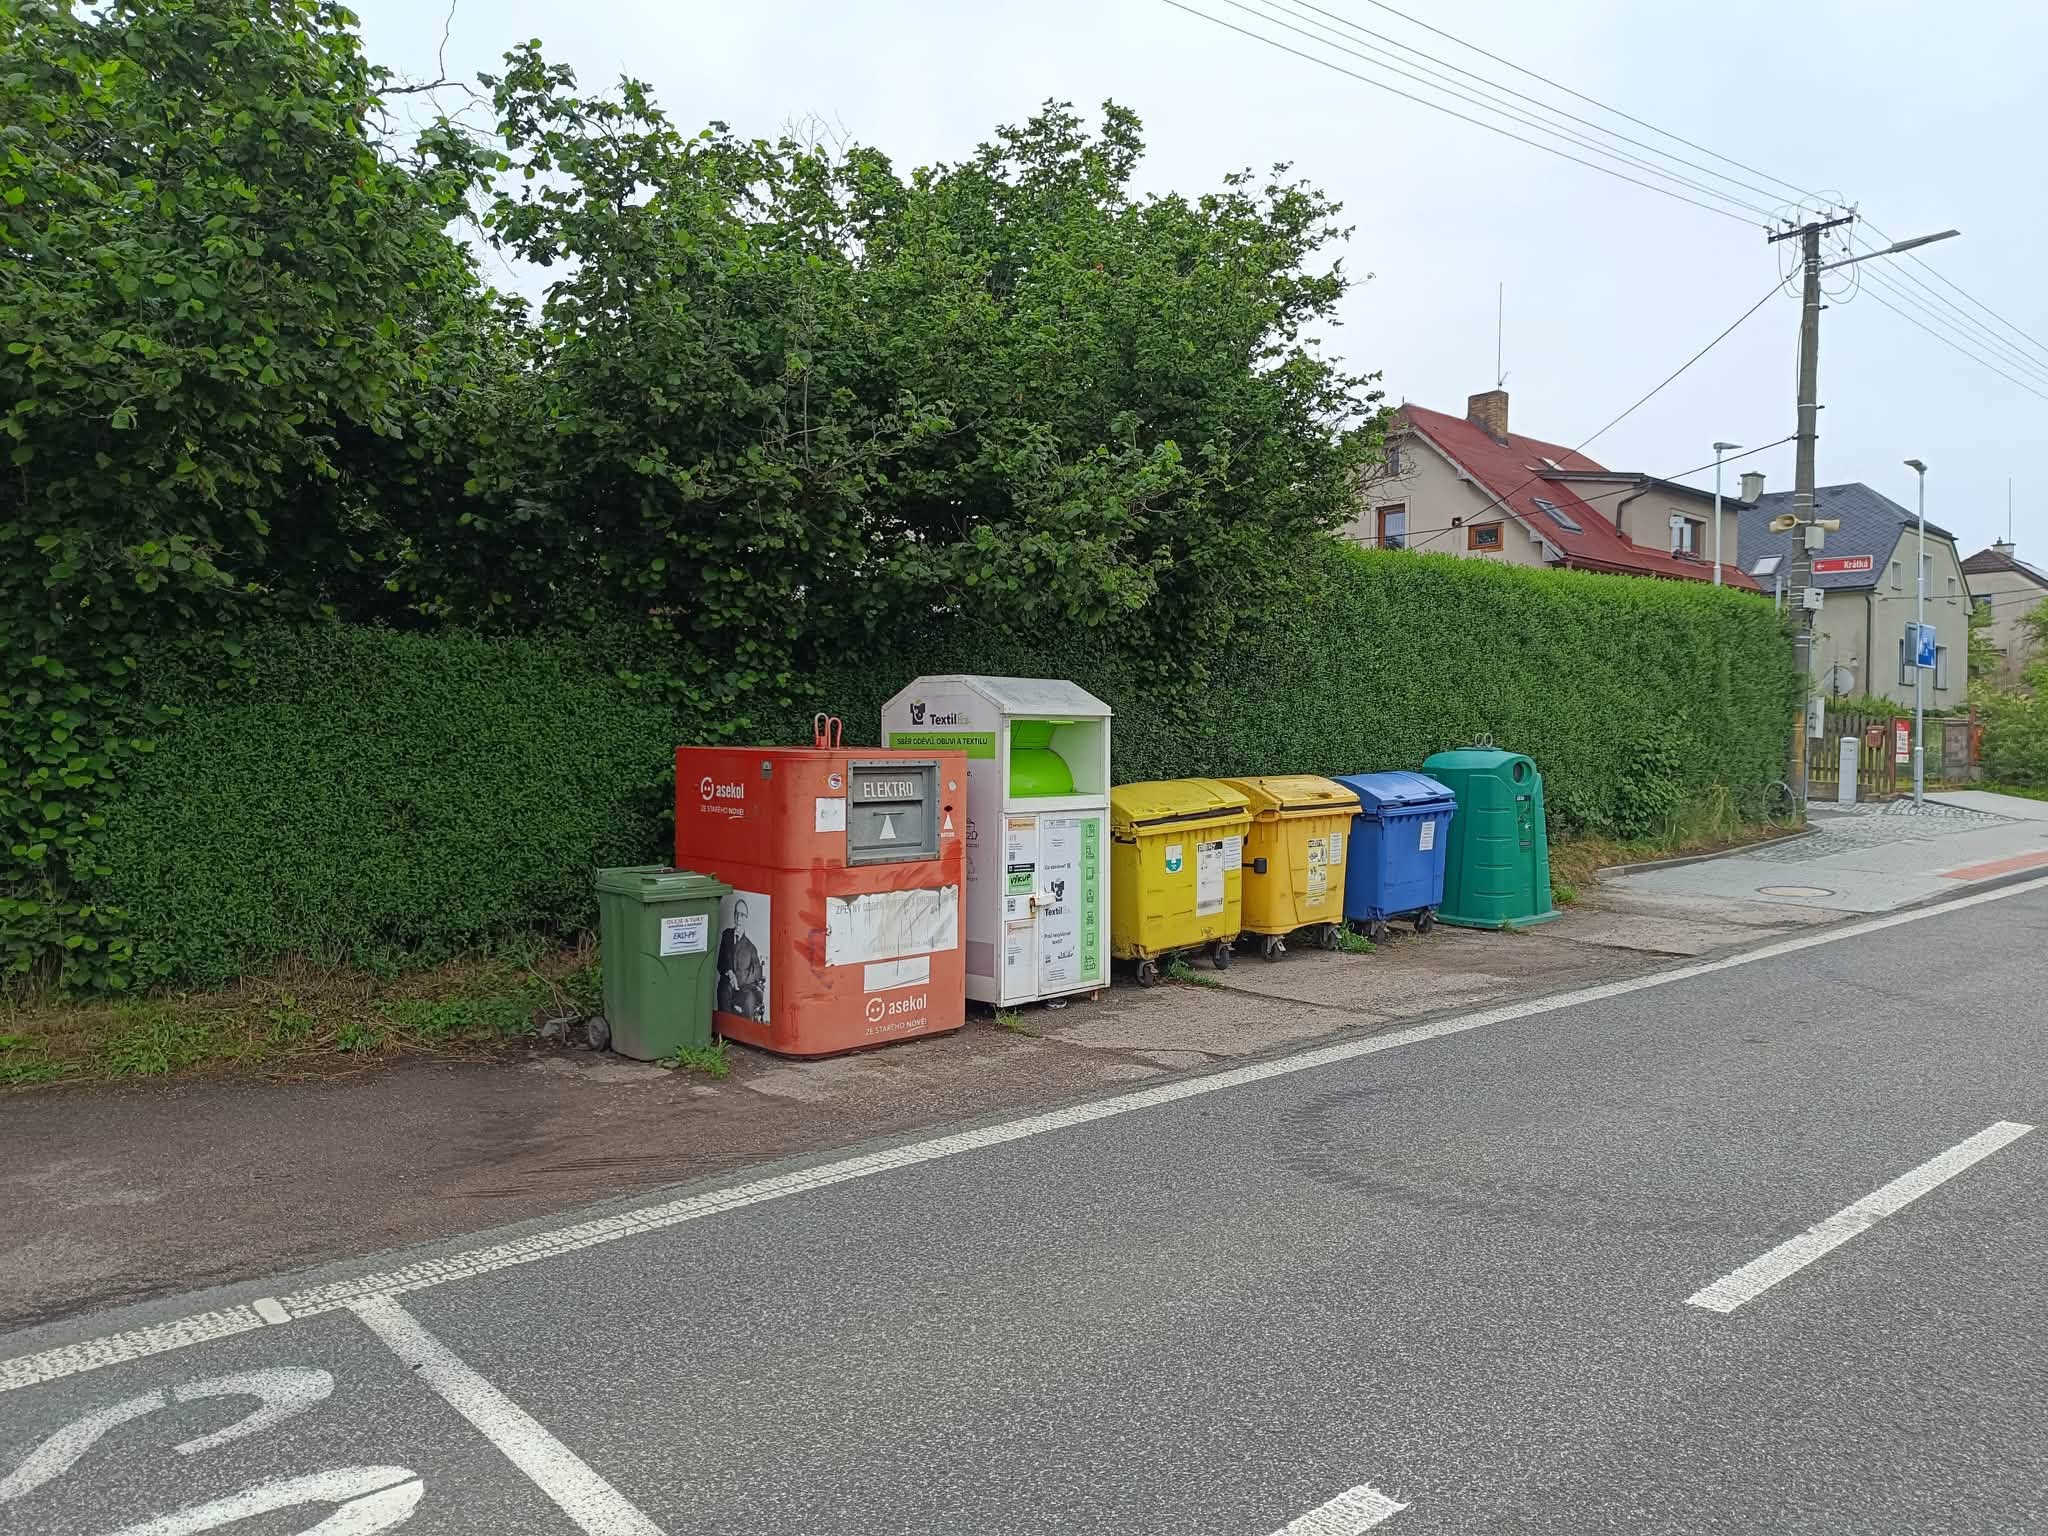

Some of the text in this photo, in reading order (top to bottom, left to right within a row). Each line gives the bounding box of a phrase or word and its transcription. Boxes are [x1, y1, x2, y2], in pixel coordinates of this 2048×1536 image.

[1843, 559, 1869, 569] Krátká
[963, 737, 988, 745] TEXTILU
[716, 782, 744, 800] asekol
[863, 781, 914, 798] ELEKTRO
[888, 993, 927, 1015] asekol
